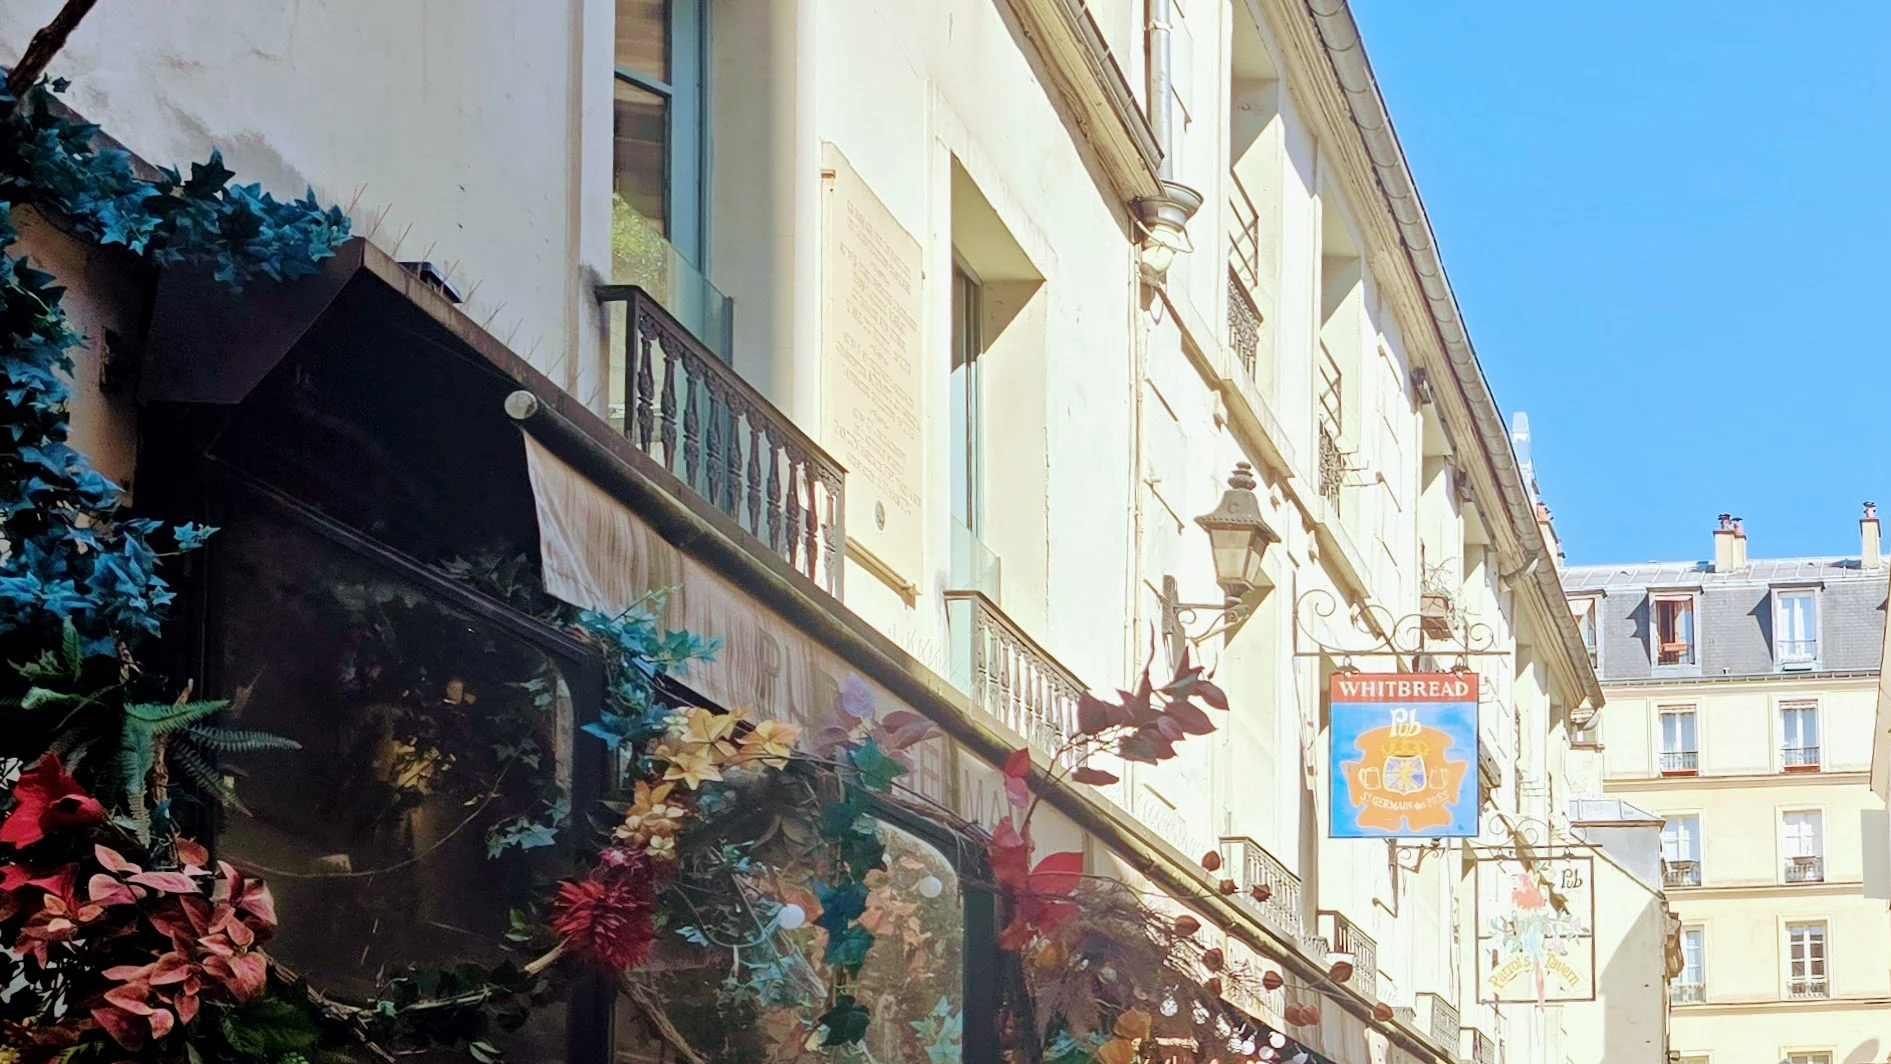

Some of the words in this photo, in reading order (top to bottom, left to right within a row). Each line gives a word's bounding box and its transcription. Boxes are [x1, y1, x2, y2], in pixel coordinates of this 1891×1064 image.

[1338, 681, 1469, 697] WHITBREAD
[1389, 708, 1422, 738] Pub
[1371, 795, 1413, 811] GERMAIN
[1560, 868, 1583, 889] Pub
[1545, 951, 1580, 987] Tavern
